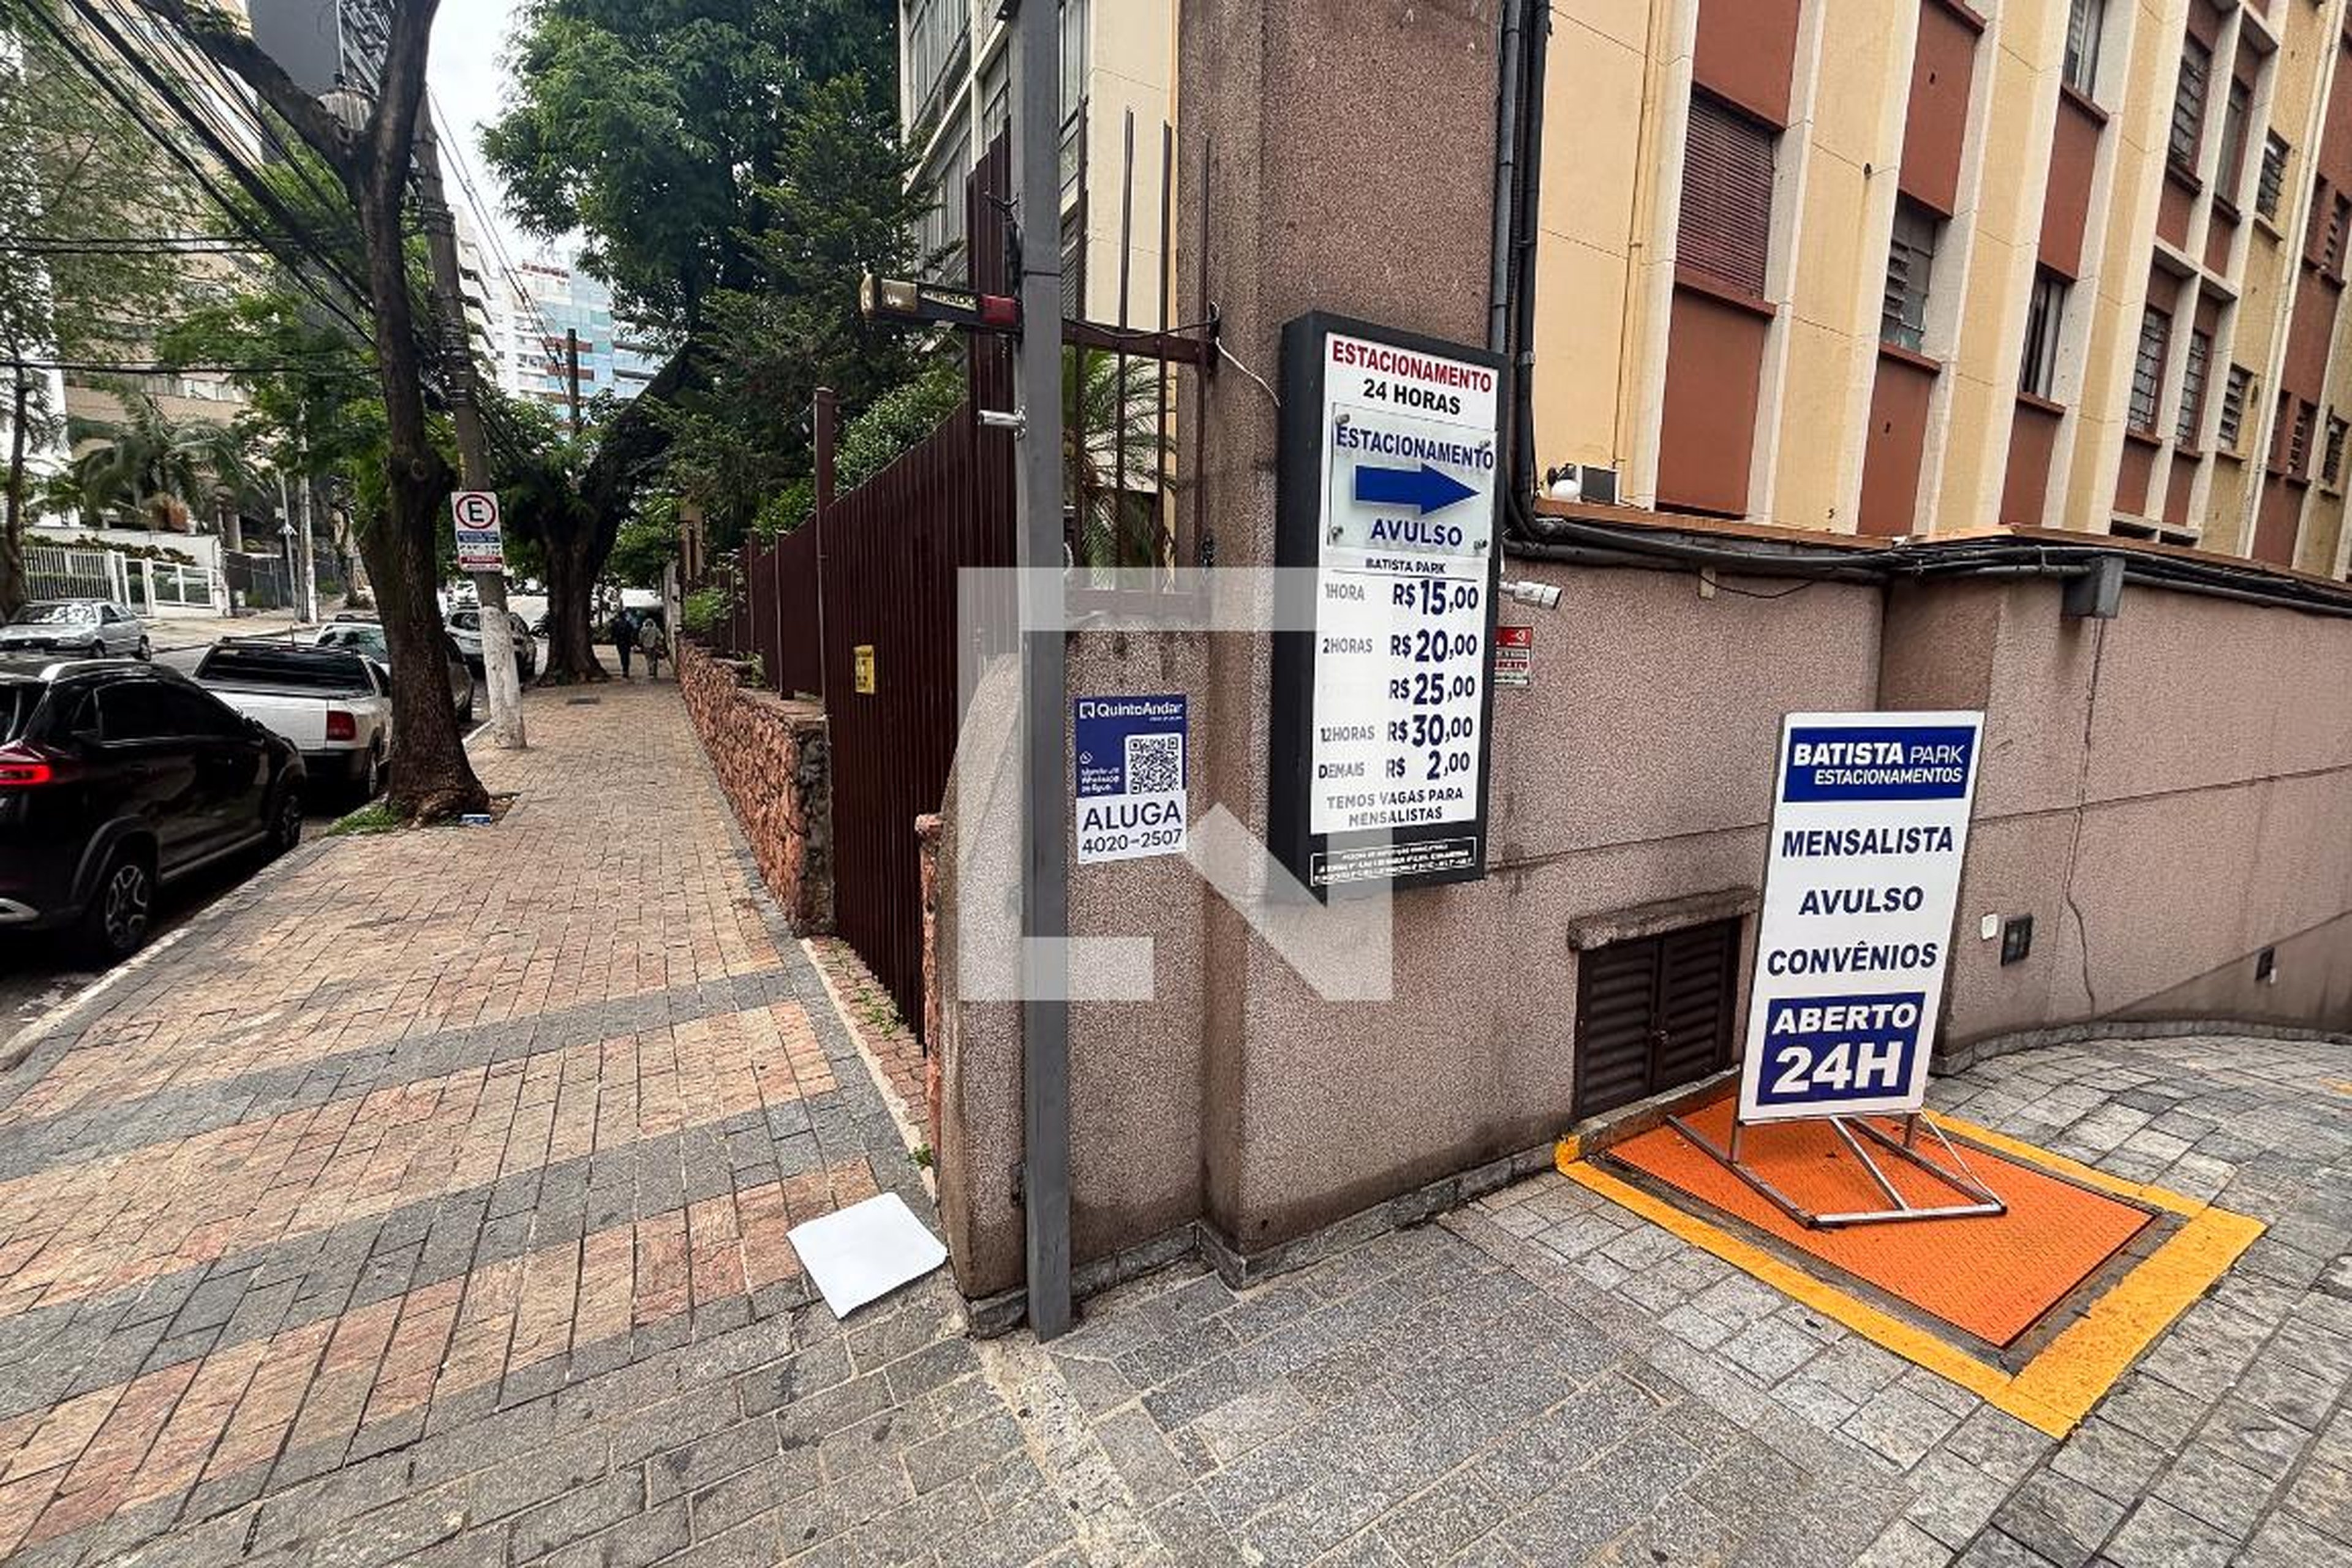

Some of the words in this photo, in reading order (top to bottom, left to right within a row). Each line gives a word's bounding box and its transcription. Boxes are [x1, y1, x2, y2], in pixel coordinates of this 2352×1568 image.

[1333, 341, 1491, 393] ESTACIONAMENTO
[1363, 379, 1387, 400] 24
[1393, 385, 1461, 415] HORAS
[1336, 425, 1494, 470] ESTACIONAMENTO
[467, 500, 484, 522] E
[1370, 519, 1462, 546] AVULSO
[1366, 558, 1414, 573] BATISTA
[1416, 561, 1446, 574] PARK
[1097, 703, 1183, 718] QuintoAndar
[1318, 761, 1365, 778] DEMAIS
[1385, 758, 1406, 778] R$
[1427, 750, 1470, 780] 2,00
[1793, 742, 1904, 767] BATISTA
[1909, 745, 1964, 765] PARK
[1814, 767, 1964, 786] ESTACIONAMENTOS
[1327, 792, 1375, 809] TEMOS
[1381, 790, 1424, 805] VAGAS
[1428, 787, 1463, 801] PARA
[1082, 800, 1182, 832] ALUGA
[1349, 807, 1442, 827] MENSALISTAS
[1082, 829, 1183, 854] 4020-2507
[1782, 826, 1953, 858] MENSALISTA
[1798, 886, 1923, 915] AVULSO
[1768, 941, 1939, 976] CONVÊNIOS
[1772, 1003, 1917, 1034] ABERTO
[1771, 1041, 1903, 1095] 24H
